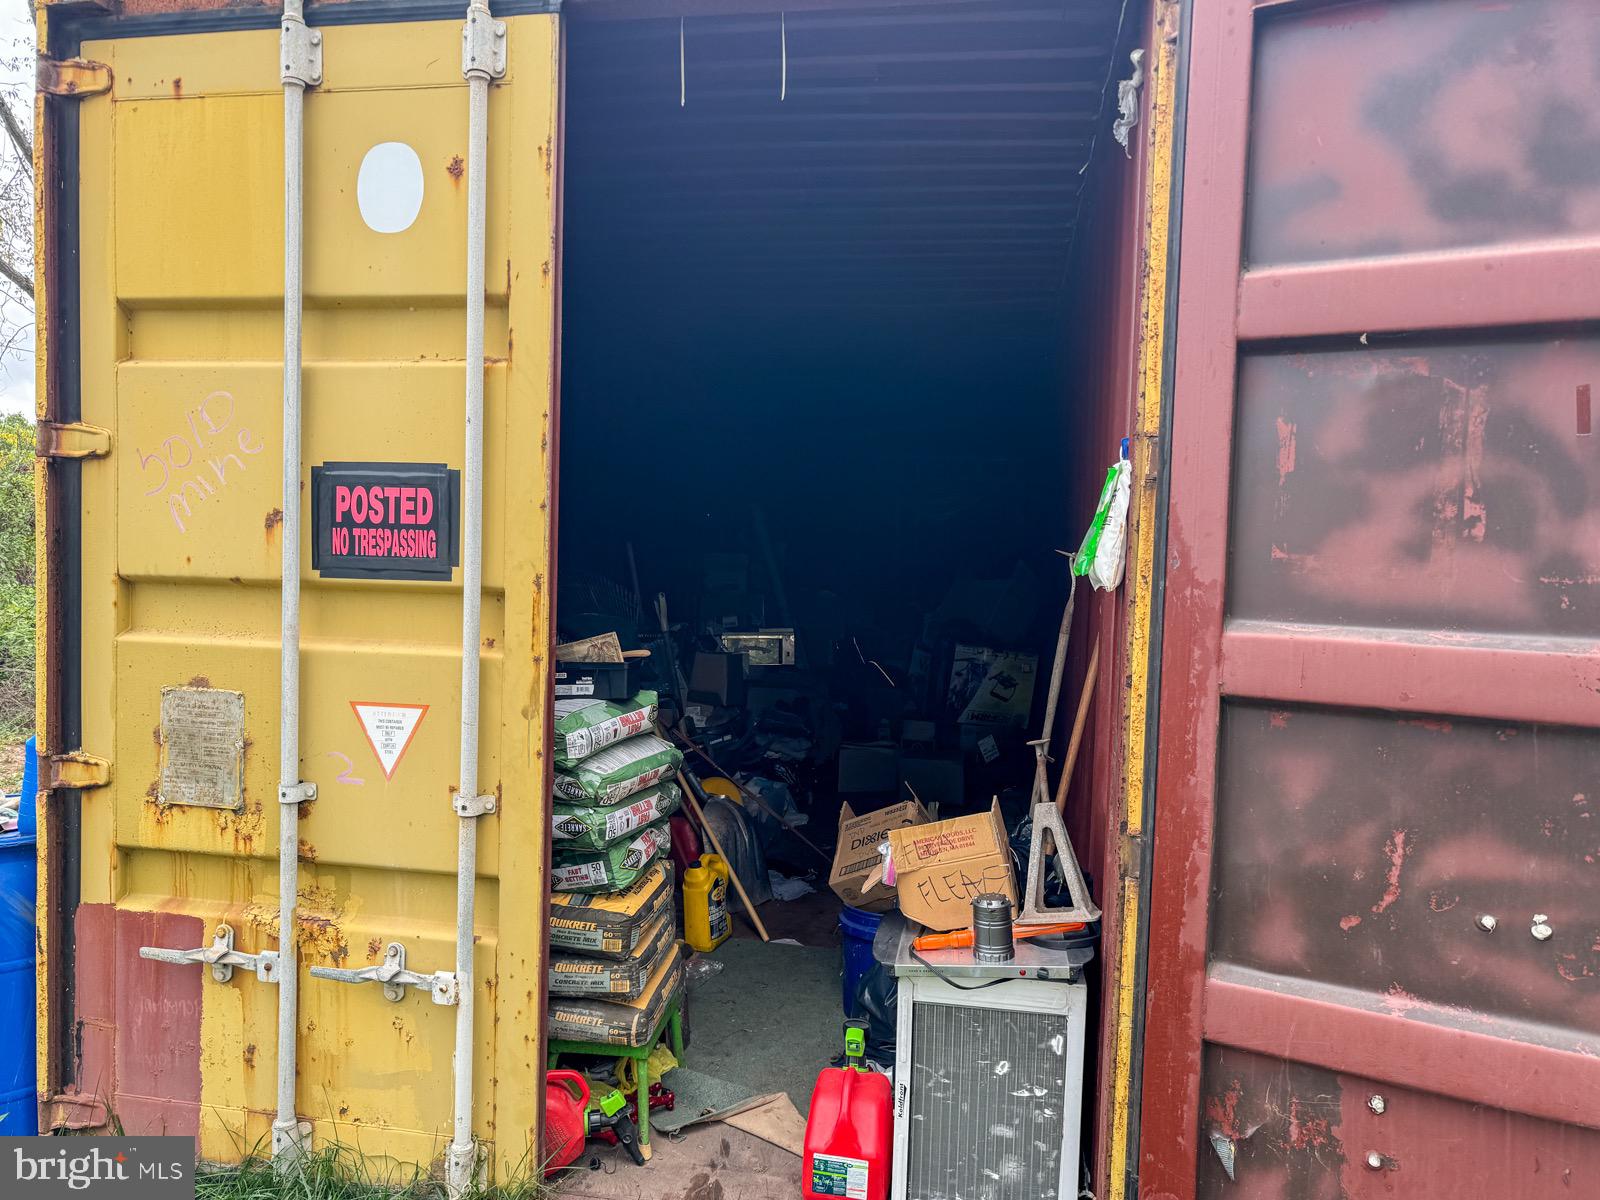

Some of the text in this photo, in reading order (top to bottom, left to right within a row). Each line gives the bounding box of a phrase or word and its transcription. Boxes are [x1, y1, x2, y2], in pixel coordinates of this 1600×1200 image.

[335, 485, 433, 525] POSTED
[331, 527, 437, 558] NO TRESPASSING
[327, 752, 365, 785] 2
[559, 782, 588, 799] SAKRETE
[560, 823, 587, 832] SAKRETE
[608, 828, 617, 839] 50
[851, 828, 891, 851] DIXIE
[591, 862, 601, 871] 50
[550, 916, 597, 931] QUIKRETE
[554, 962, 604, 974] QUIKRETE
[554, 1011, 604, 1027] QUIKRETE
